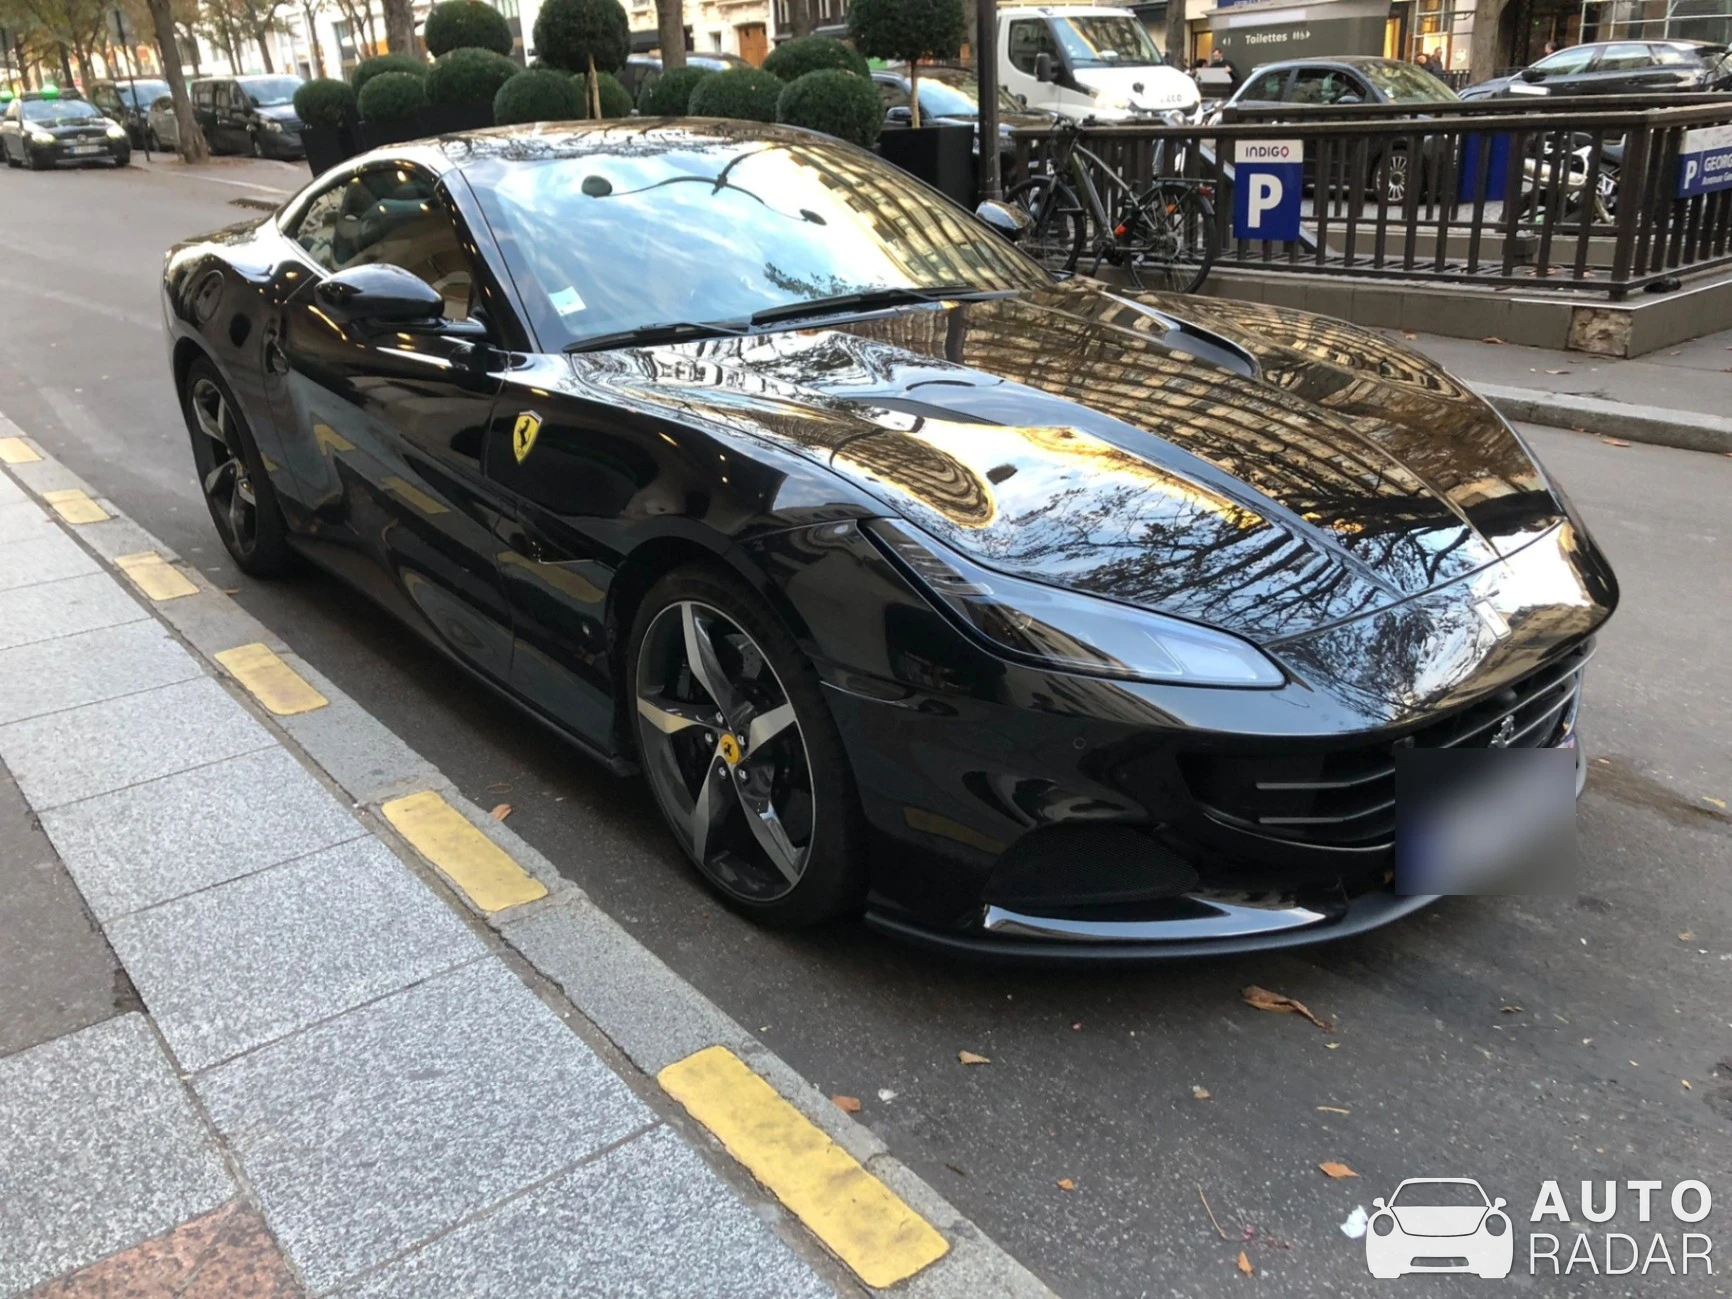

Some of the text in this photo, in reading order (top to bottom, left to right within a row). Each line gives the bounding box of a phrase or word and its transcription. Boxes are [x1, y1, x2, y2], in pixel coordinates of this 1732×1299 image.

[1245, 33, 1288, 45] Toilettes
[1245, 146, 1290, 158] INDIGO
[1683, 160, 1698, 189] P
[1247, 173, 1283, 228] P
